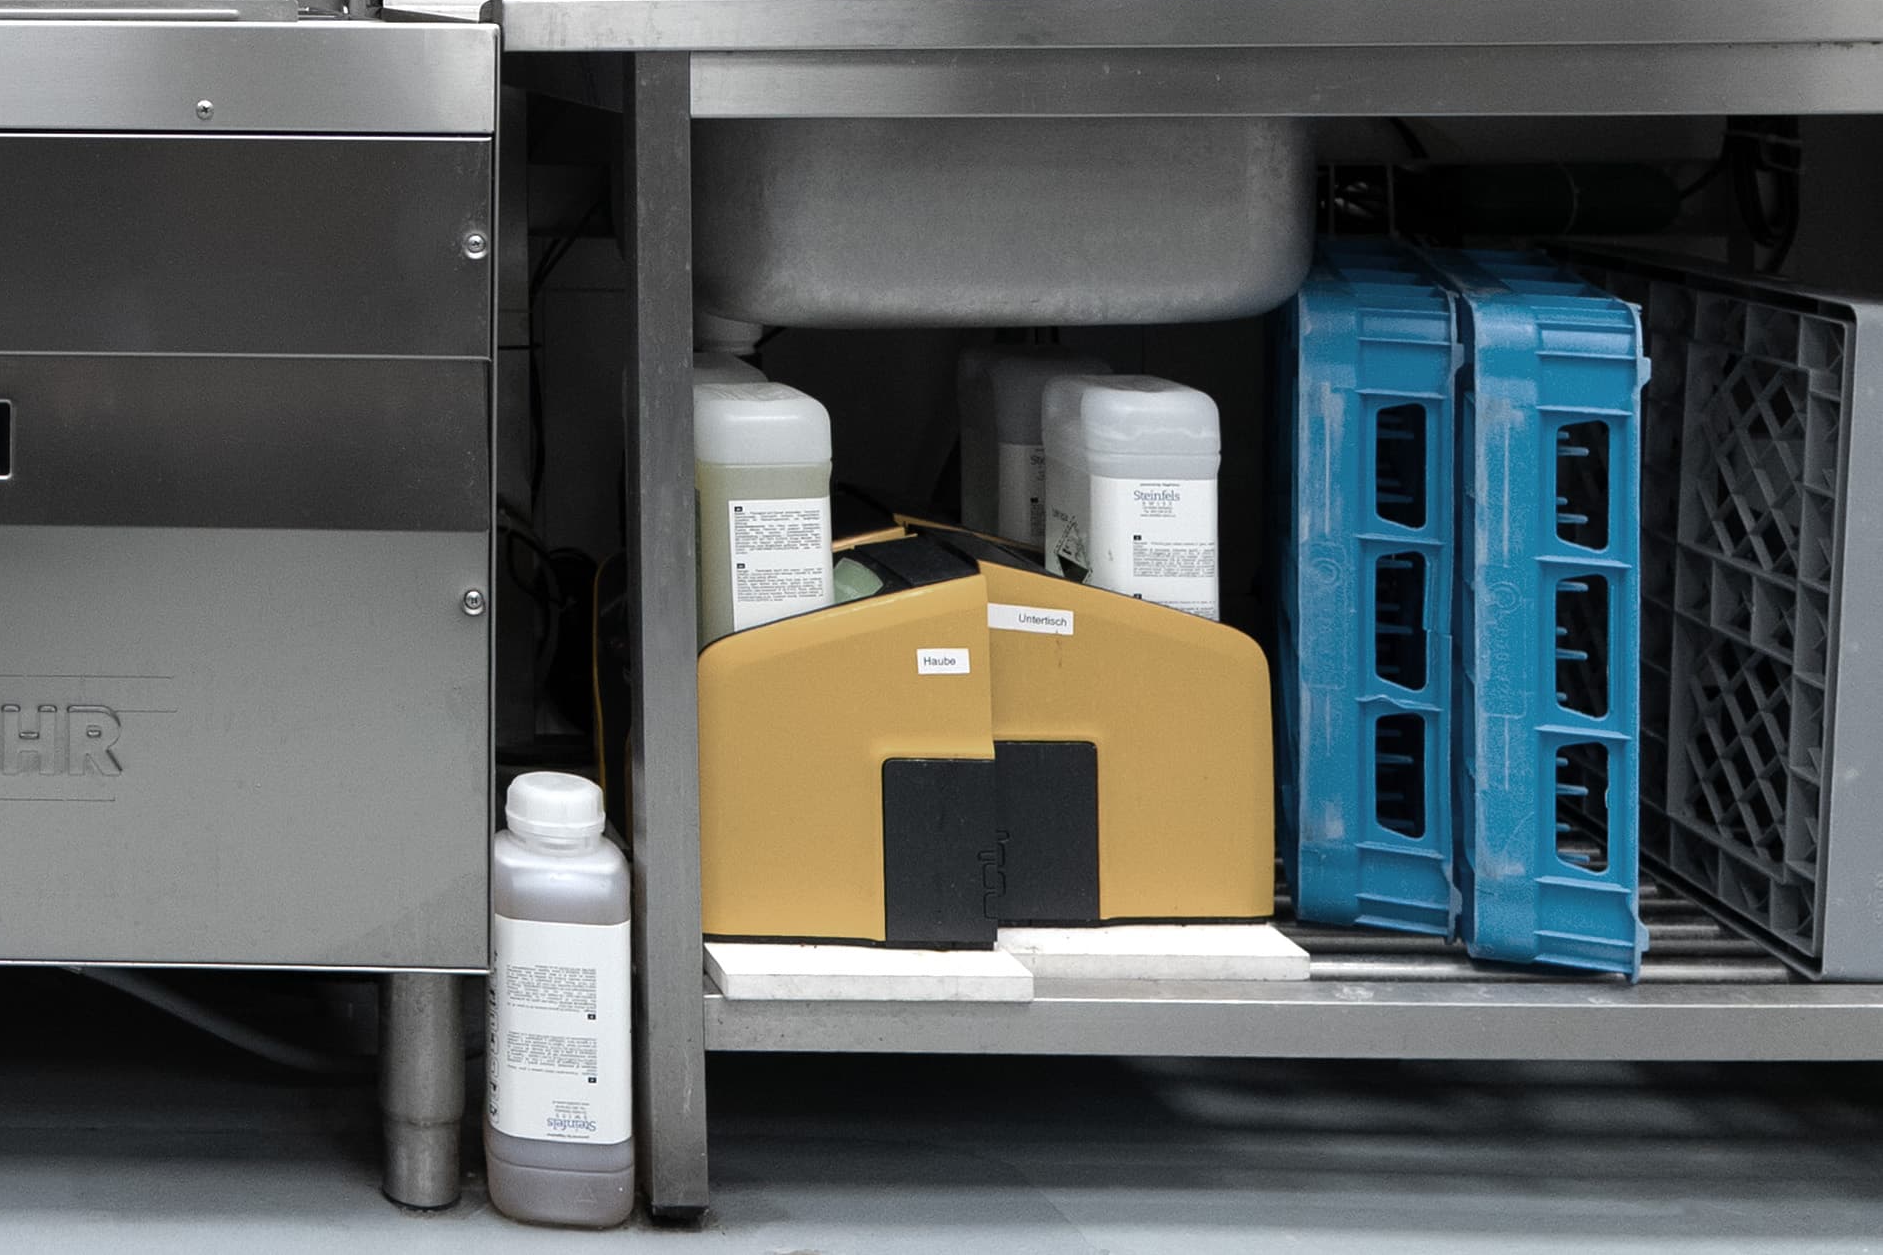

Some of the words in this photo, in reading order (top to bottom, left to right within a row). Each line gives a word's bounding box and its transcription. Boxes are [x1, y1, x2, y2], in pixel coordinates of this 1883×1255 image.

[1133, 489, 1180, 502] Steinfels
[1018, 613, 1067, 627] Untertisch
[923, 655, 956, 667] Haube
[547, 1118, 597, 1133] Steinfels
